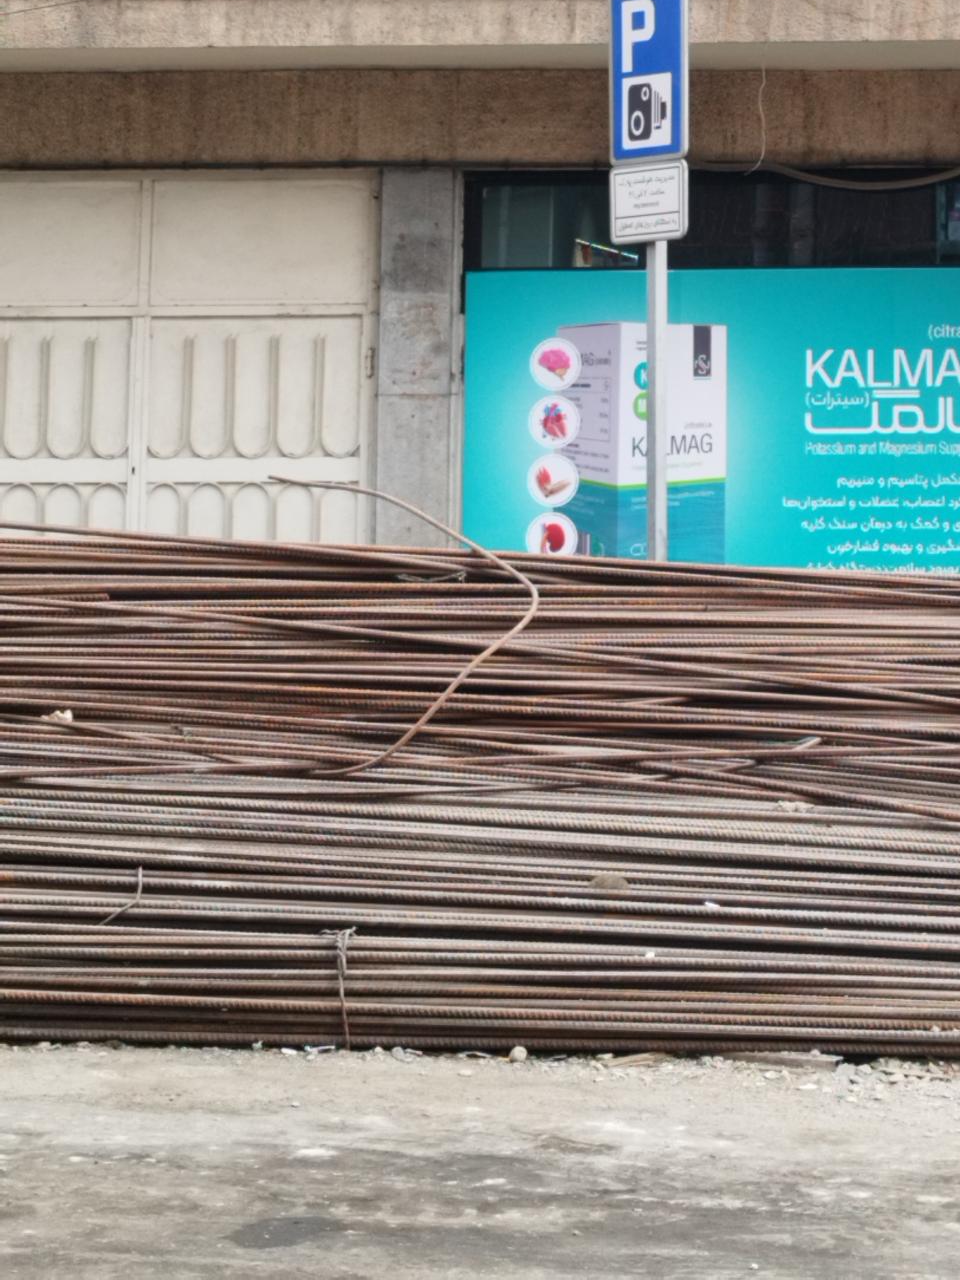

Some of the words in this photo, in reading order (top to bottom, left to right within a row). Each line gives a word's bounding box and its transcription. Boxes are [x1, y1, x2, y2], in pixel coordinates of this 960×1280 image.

[632, 432, 713, 458] KMAG
[805, 441, 857, 455] Potassium
[859, 441, 877, 454] and
[879, 441, 936, 457] Magnesium
[877, 476, 887, 488] و
[887, 474, 930, 489] پتاسیم
[849, 499, 857, 509] و
[943, 520, 950, 532] و
[916, 542, 924, 555] و
